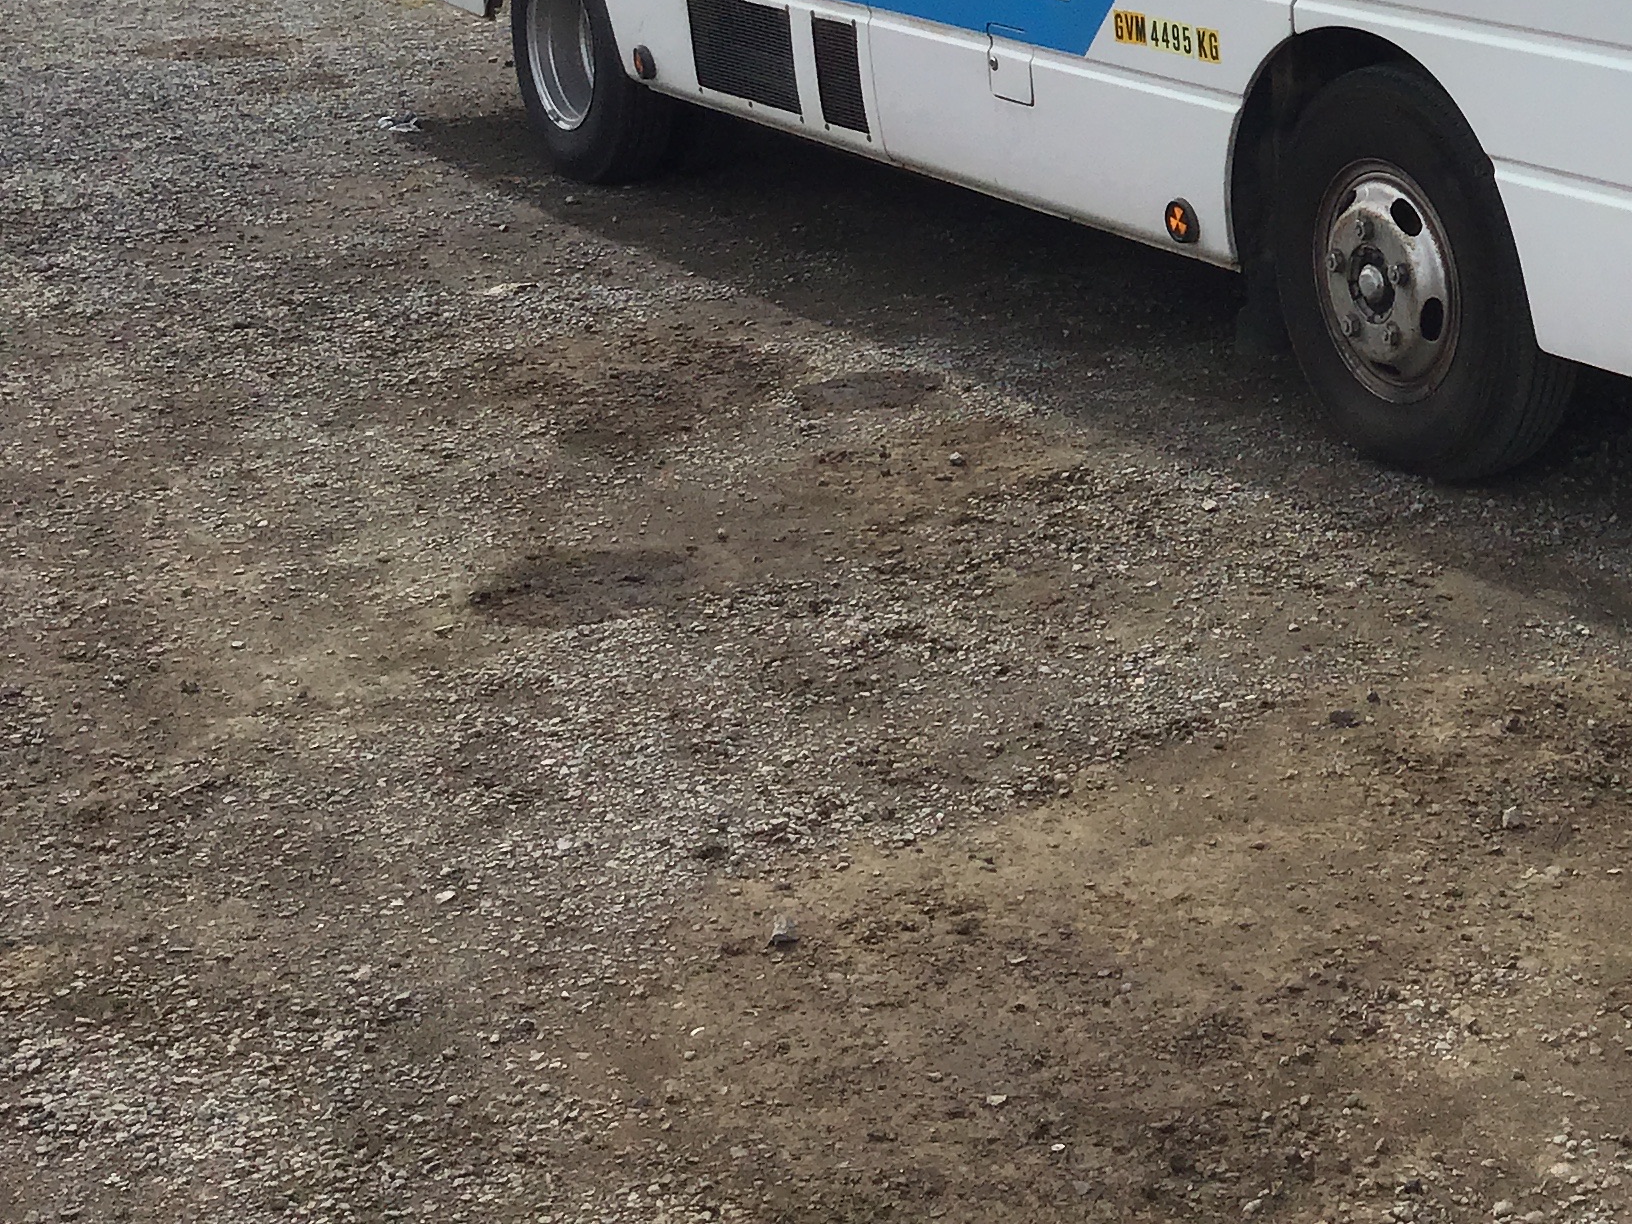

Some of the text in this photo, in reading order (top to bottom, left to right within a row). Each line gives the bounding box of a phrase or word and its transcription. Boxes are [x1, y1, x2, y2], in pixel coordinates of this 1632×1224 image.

[1114, 13, 1219, 60] GVM 4495 KG
